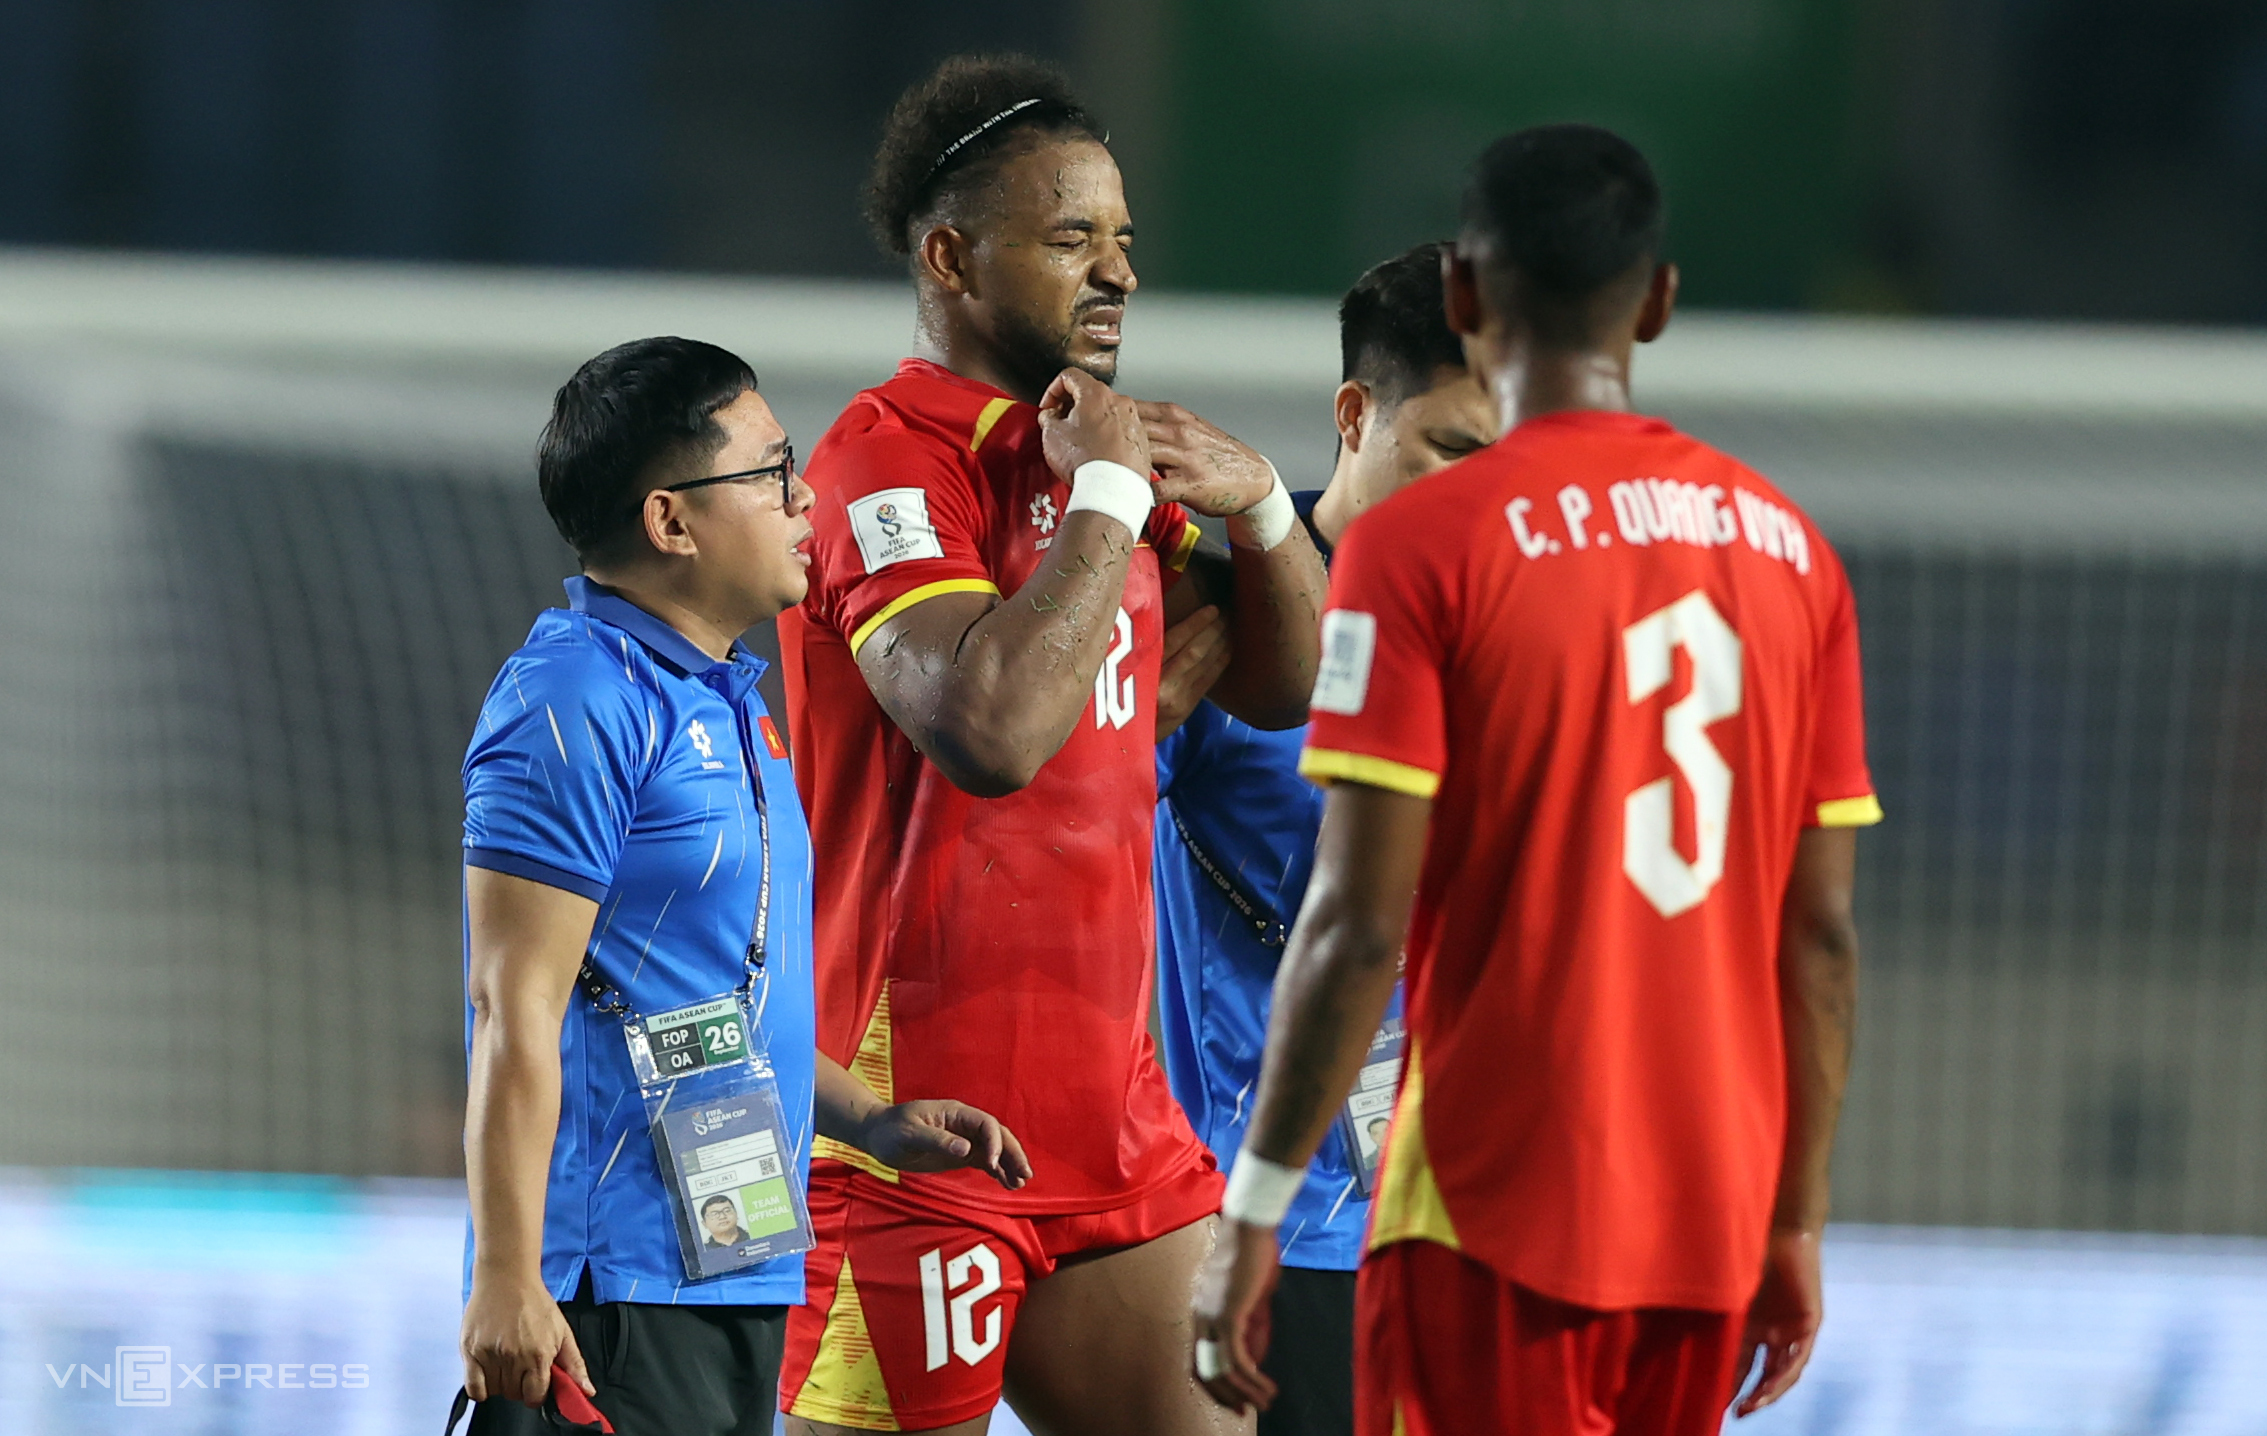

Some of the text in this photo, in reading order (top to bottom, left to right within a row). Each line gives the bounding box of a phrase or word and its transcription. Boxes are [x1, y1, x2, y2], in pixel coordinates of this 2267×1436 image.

[1505, 496, 1562, 560] C.
[1557, 484, 1612, 550] P.
[880, 539, 921, 559] ASEAN CUP
[888, 537, 906, 547] FIFA
[1624, 588, 1742, 919] 3
[1213, 871, 1231, 890] CUP
[761, 883, 769, 908] CUP
[658, 1014, 678, 1025] FIFA
[678, 1007, 706, 1020] ASEAN
[661, 1029, 689, 1048] FOP
[704, 1021, 742, 1051] 26
[670, 1051, 693, 1068] OA
[705, 1108, 722, 1119] FIFA
[708, 1108, 747, 1124] ASEAN CUP
[752, 1195, 780, 1209] TEAM
[747, 1205, 790, 1222] OFFICIAL
[919, 1243, 1002, 1372] 12
